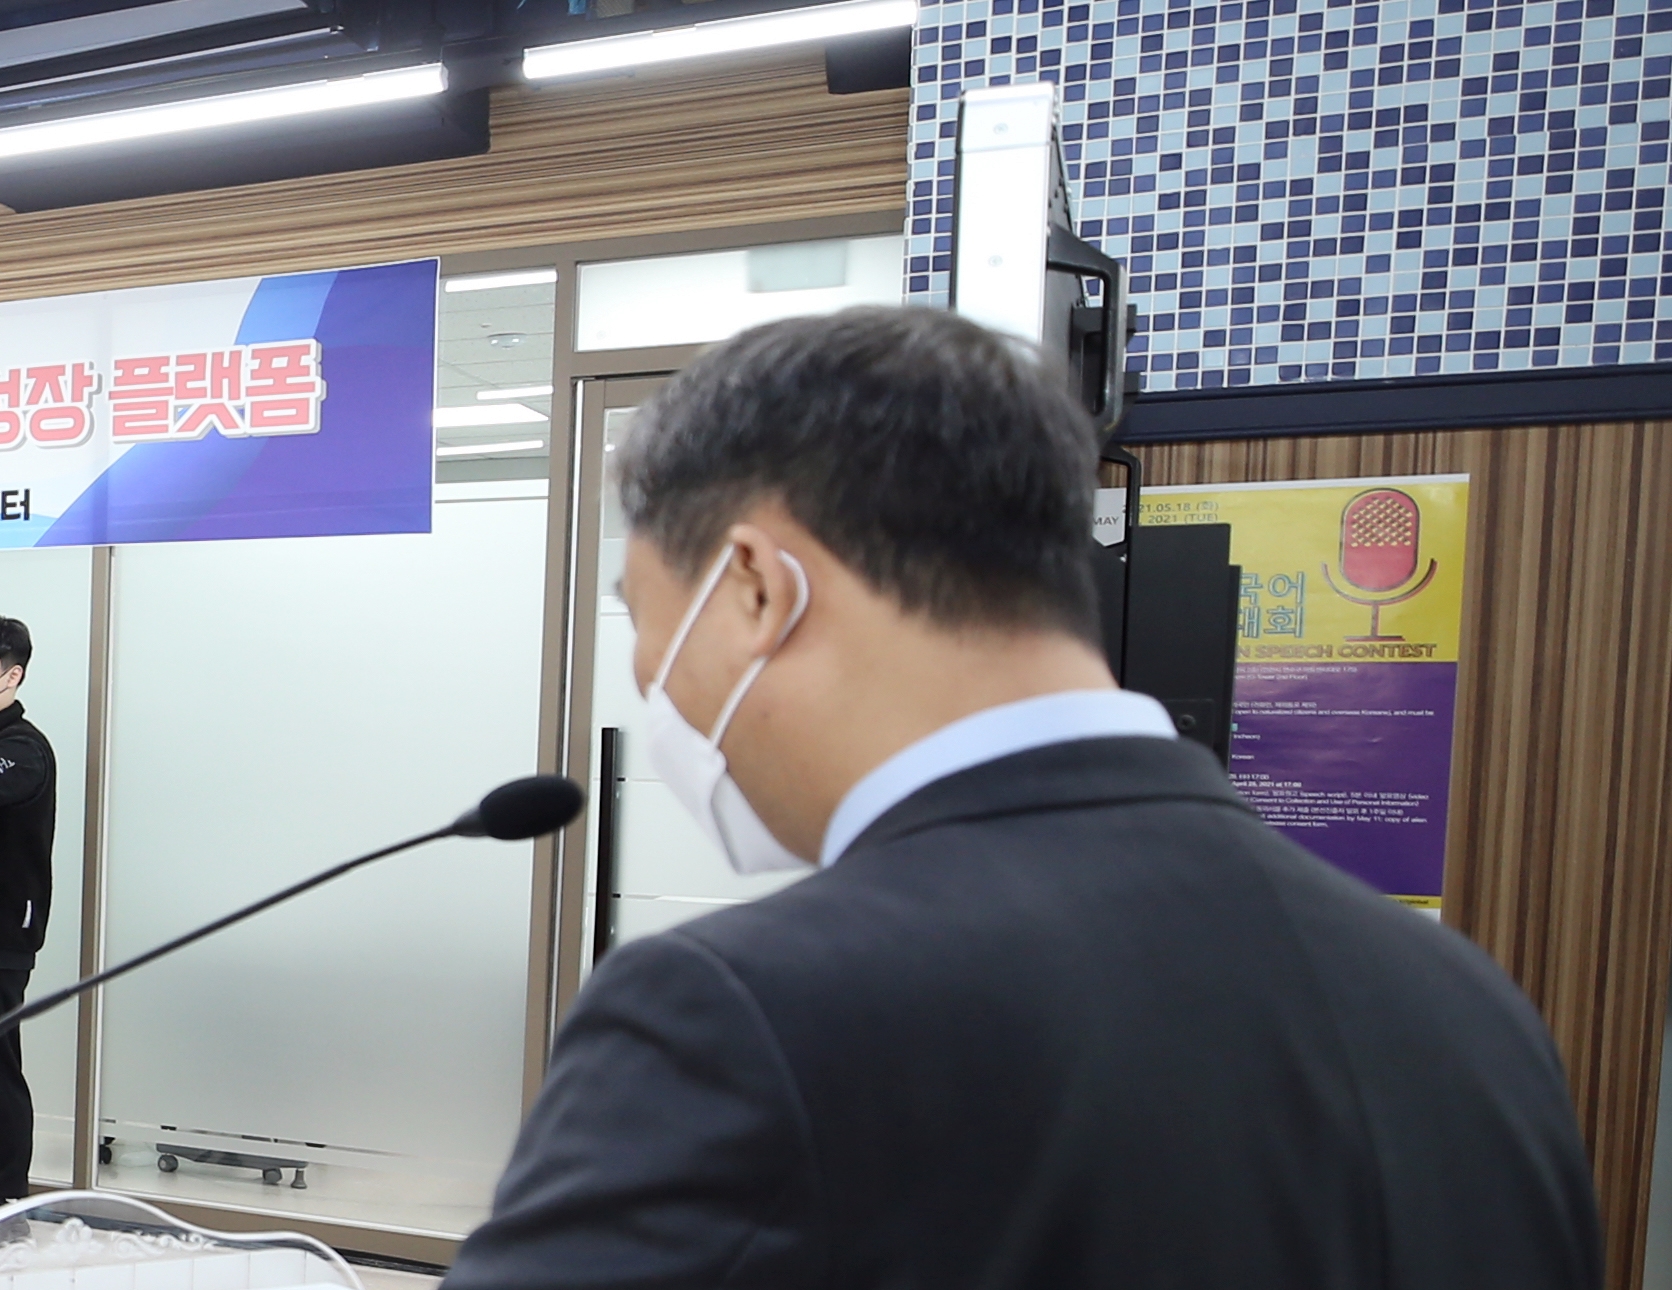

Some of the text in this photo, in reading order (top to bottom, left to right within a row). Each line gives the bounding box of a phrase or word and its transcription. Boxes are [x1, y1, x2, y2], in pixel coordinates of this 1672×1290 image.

[108, 340, 323, 438] 플랫폼
[1122, 502, 1191, 513] 21.05.18
[1148, 514, 1178, 525] 2021
[1254, 643, 1332, 658] SPEECH
[1337, 642, 1438, 659] CONTEST
